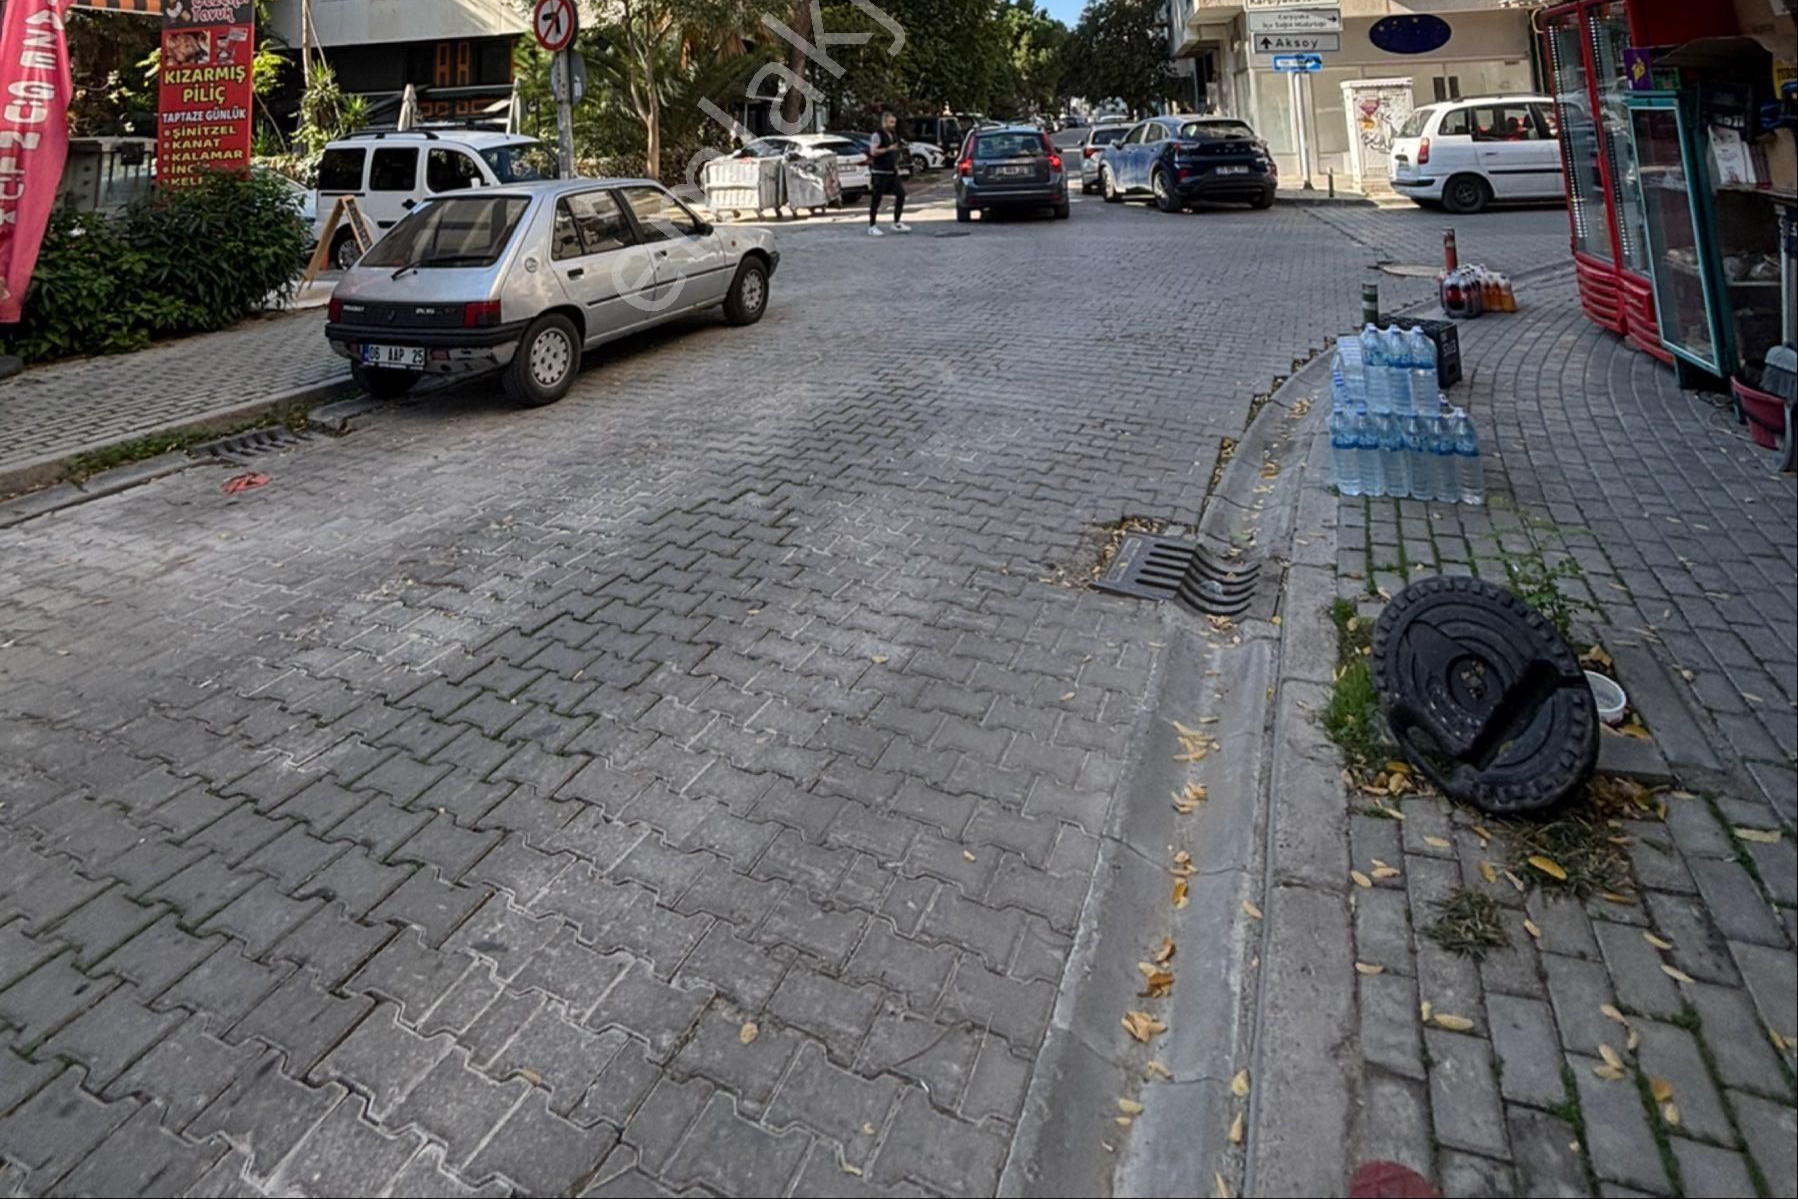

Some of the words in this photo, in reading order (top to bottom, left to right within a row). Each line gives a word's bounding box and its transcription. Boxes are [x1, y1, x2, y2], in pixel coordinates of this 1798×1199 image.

[1275, 38, 1319, 49] Aksoy
[164, 65, 246, 84] KIZARMIŞ
[183, 84, 225, 103] PİLİÇ
[162, 111, 204, 123] TAPTAZE
[205, 105, 247, 121] GÜNLÜK
[172, 125, 237, 139] ŞİNİTZEL
[172, 138, 221, 149] KANAT
[171, 149, 243, 161] KALAMAR
